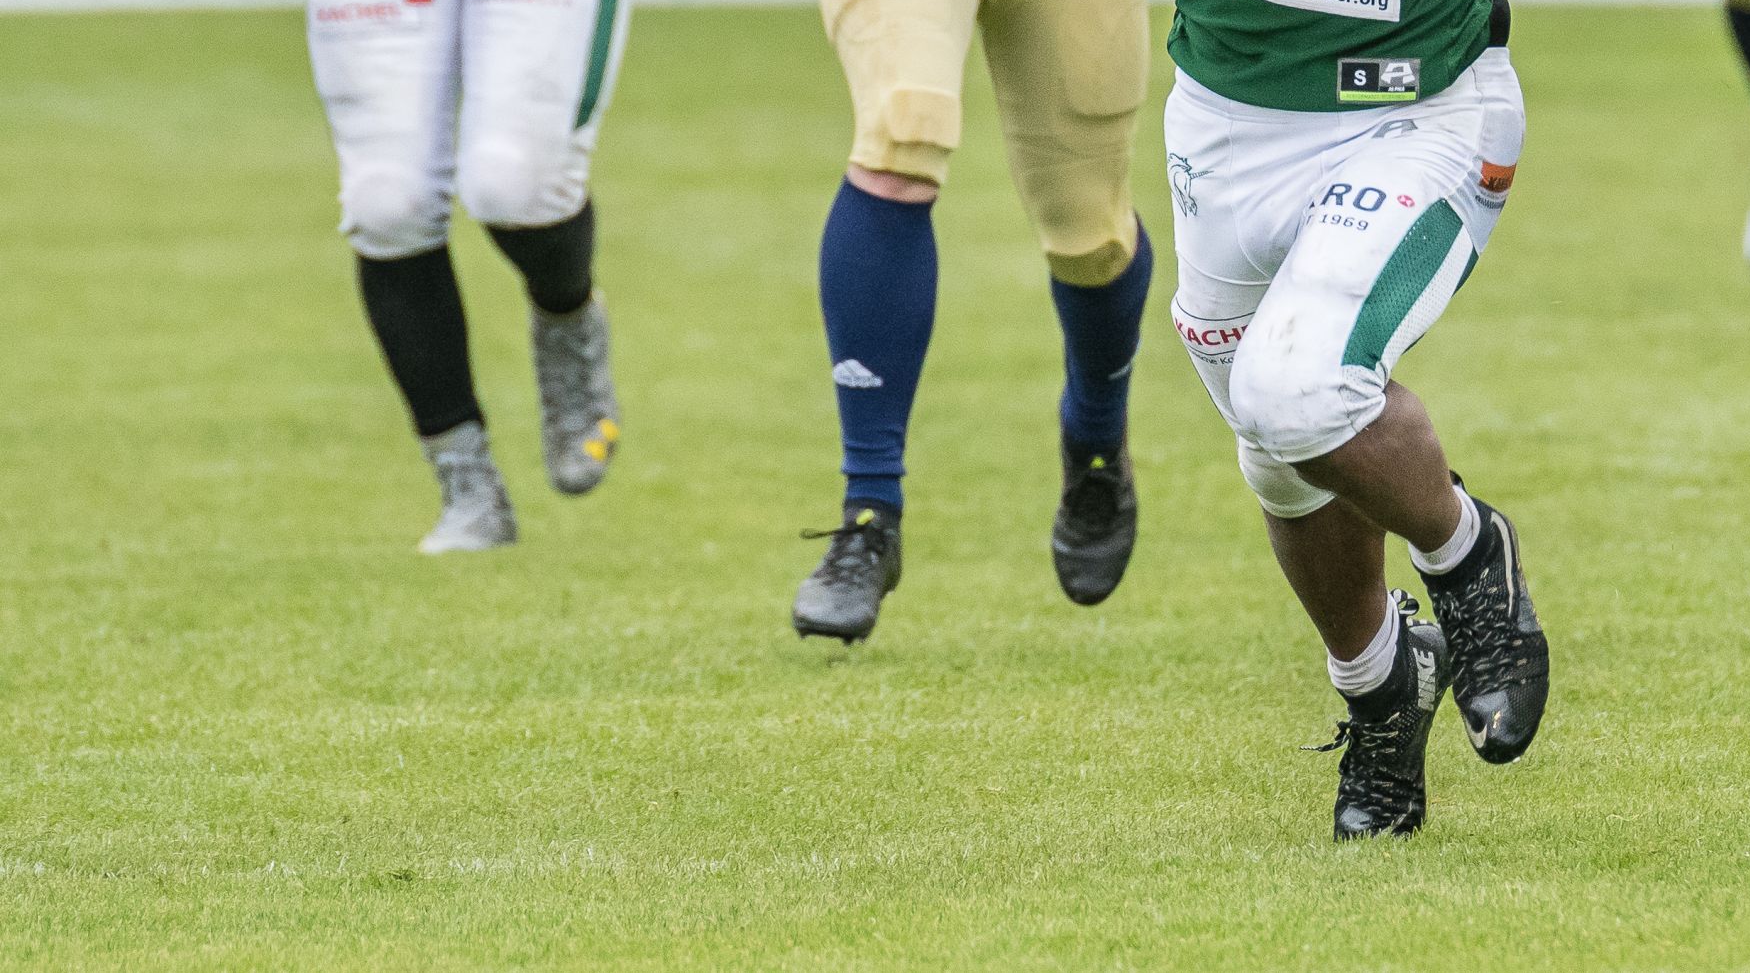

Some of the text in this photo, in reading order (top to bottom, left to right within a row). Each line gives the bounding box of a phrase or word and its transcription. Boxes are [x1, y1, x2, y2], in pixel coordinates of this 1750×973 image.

[1353, 69, 1367, 86] S
[1320, 214, 1369, 231] 1969
[1412, 647, 1436, 712] NIKE
